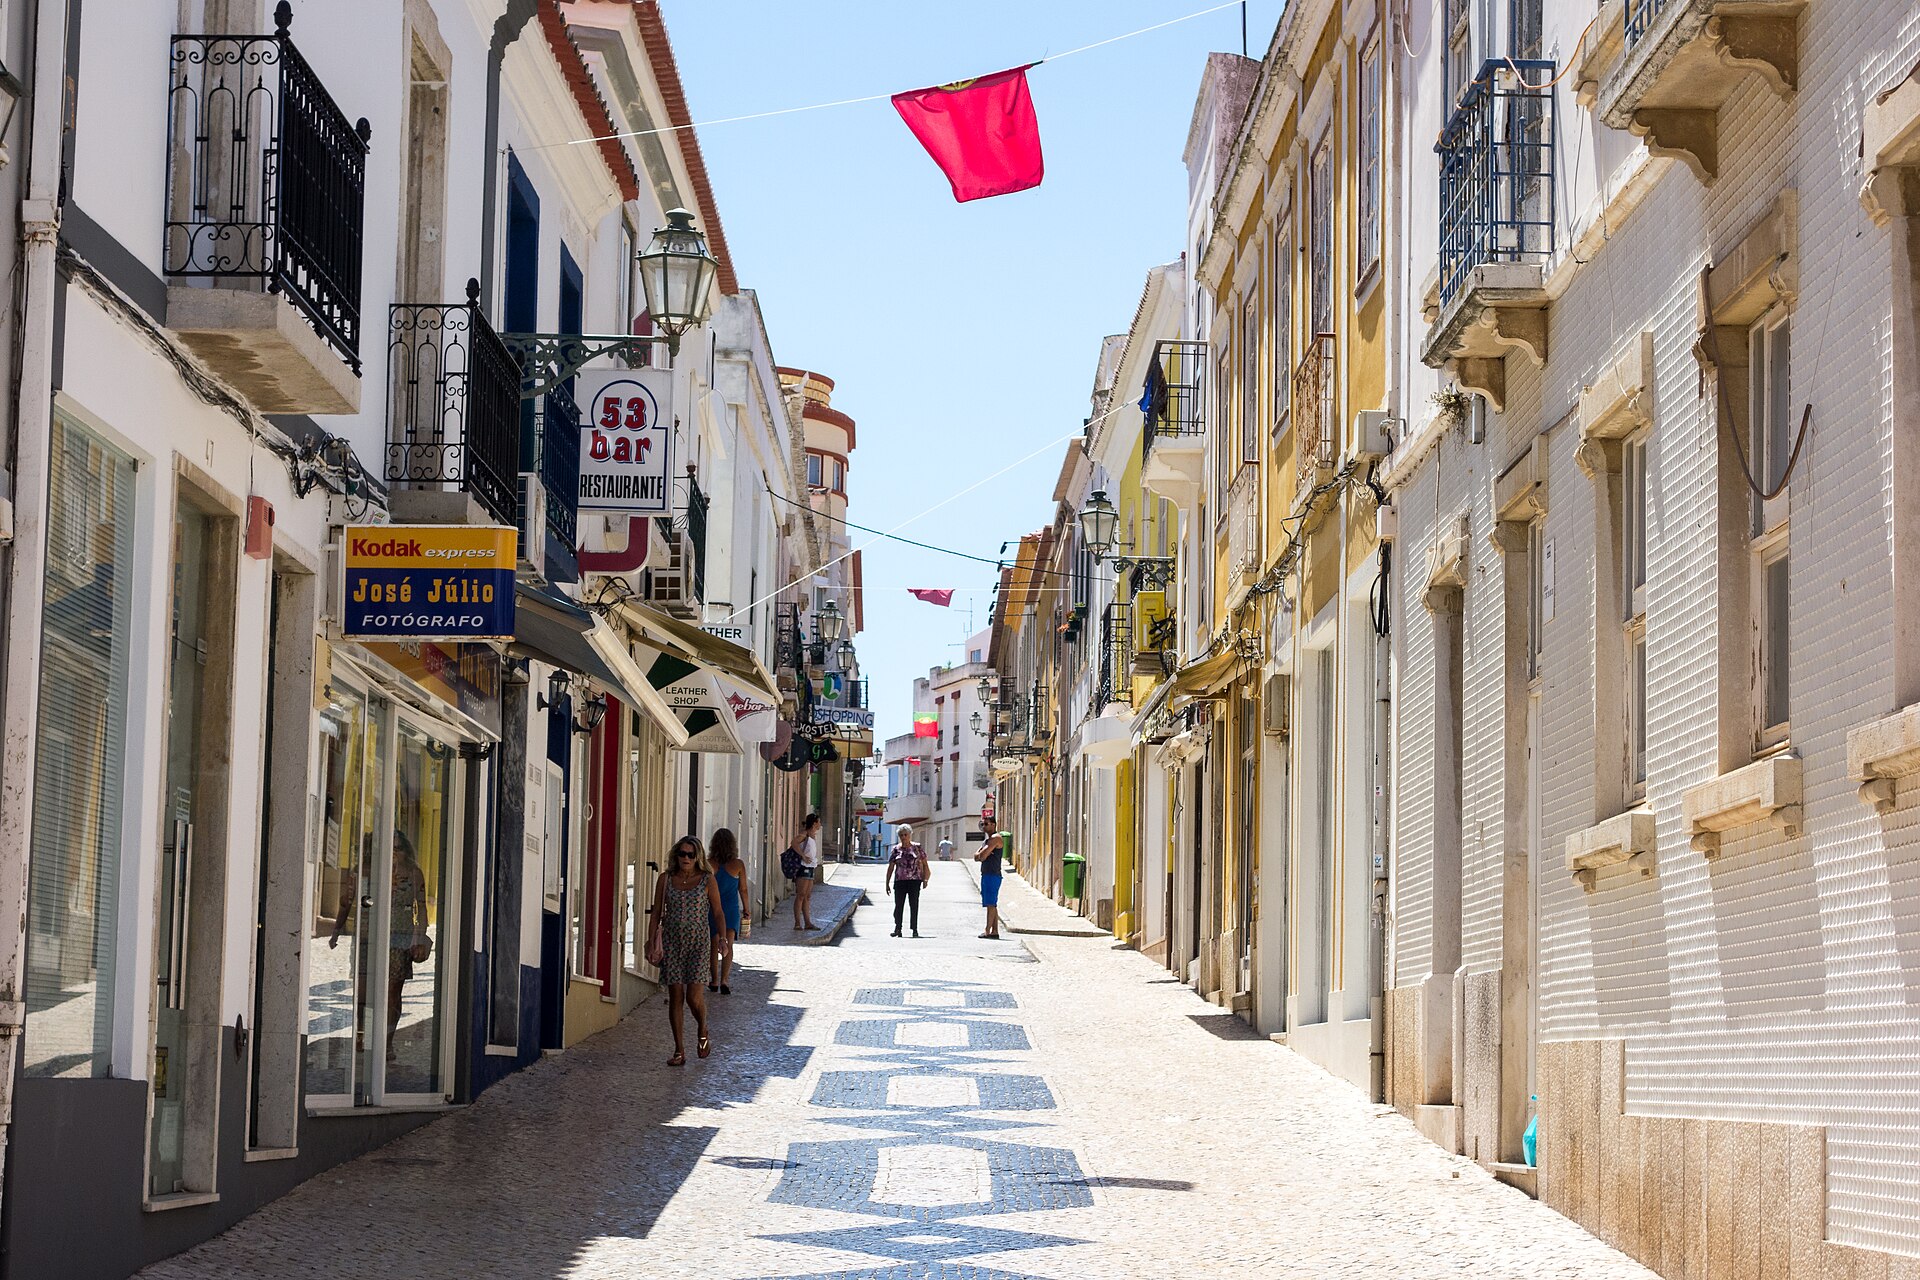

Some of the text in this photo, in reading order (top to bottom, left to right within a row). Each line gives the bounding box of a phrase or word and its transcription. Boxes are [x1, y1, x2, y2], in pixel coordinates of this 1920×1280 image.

[600, 396, 647, 431] 53
[589, 428, 653, 465] bar
[580, 474, 663, 500] RESTAURANTE
[352, 538, 496, 560] Kodak express
[353, 576, 494, 603] José Júlio
[361, 612, 484, 628] FOTÓGRAFO
[665, 686, 708, 696] LEATHER
[673, 696, 700, 705] SHOP
[799, 722, 836, 736] HOSTEL
